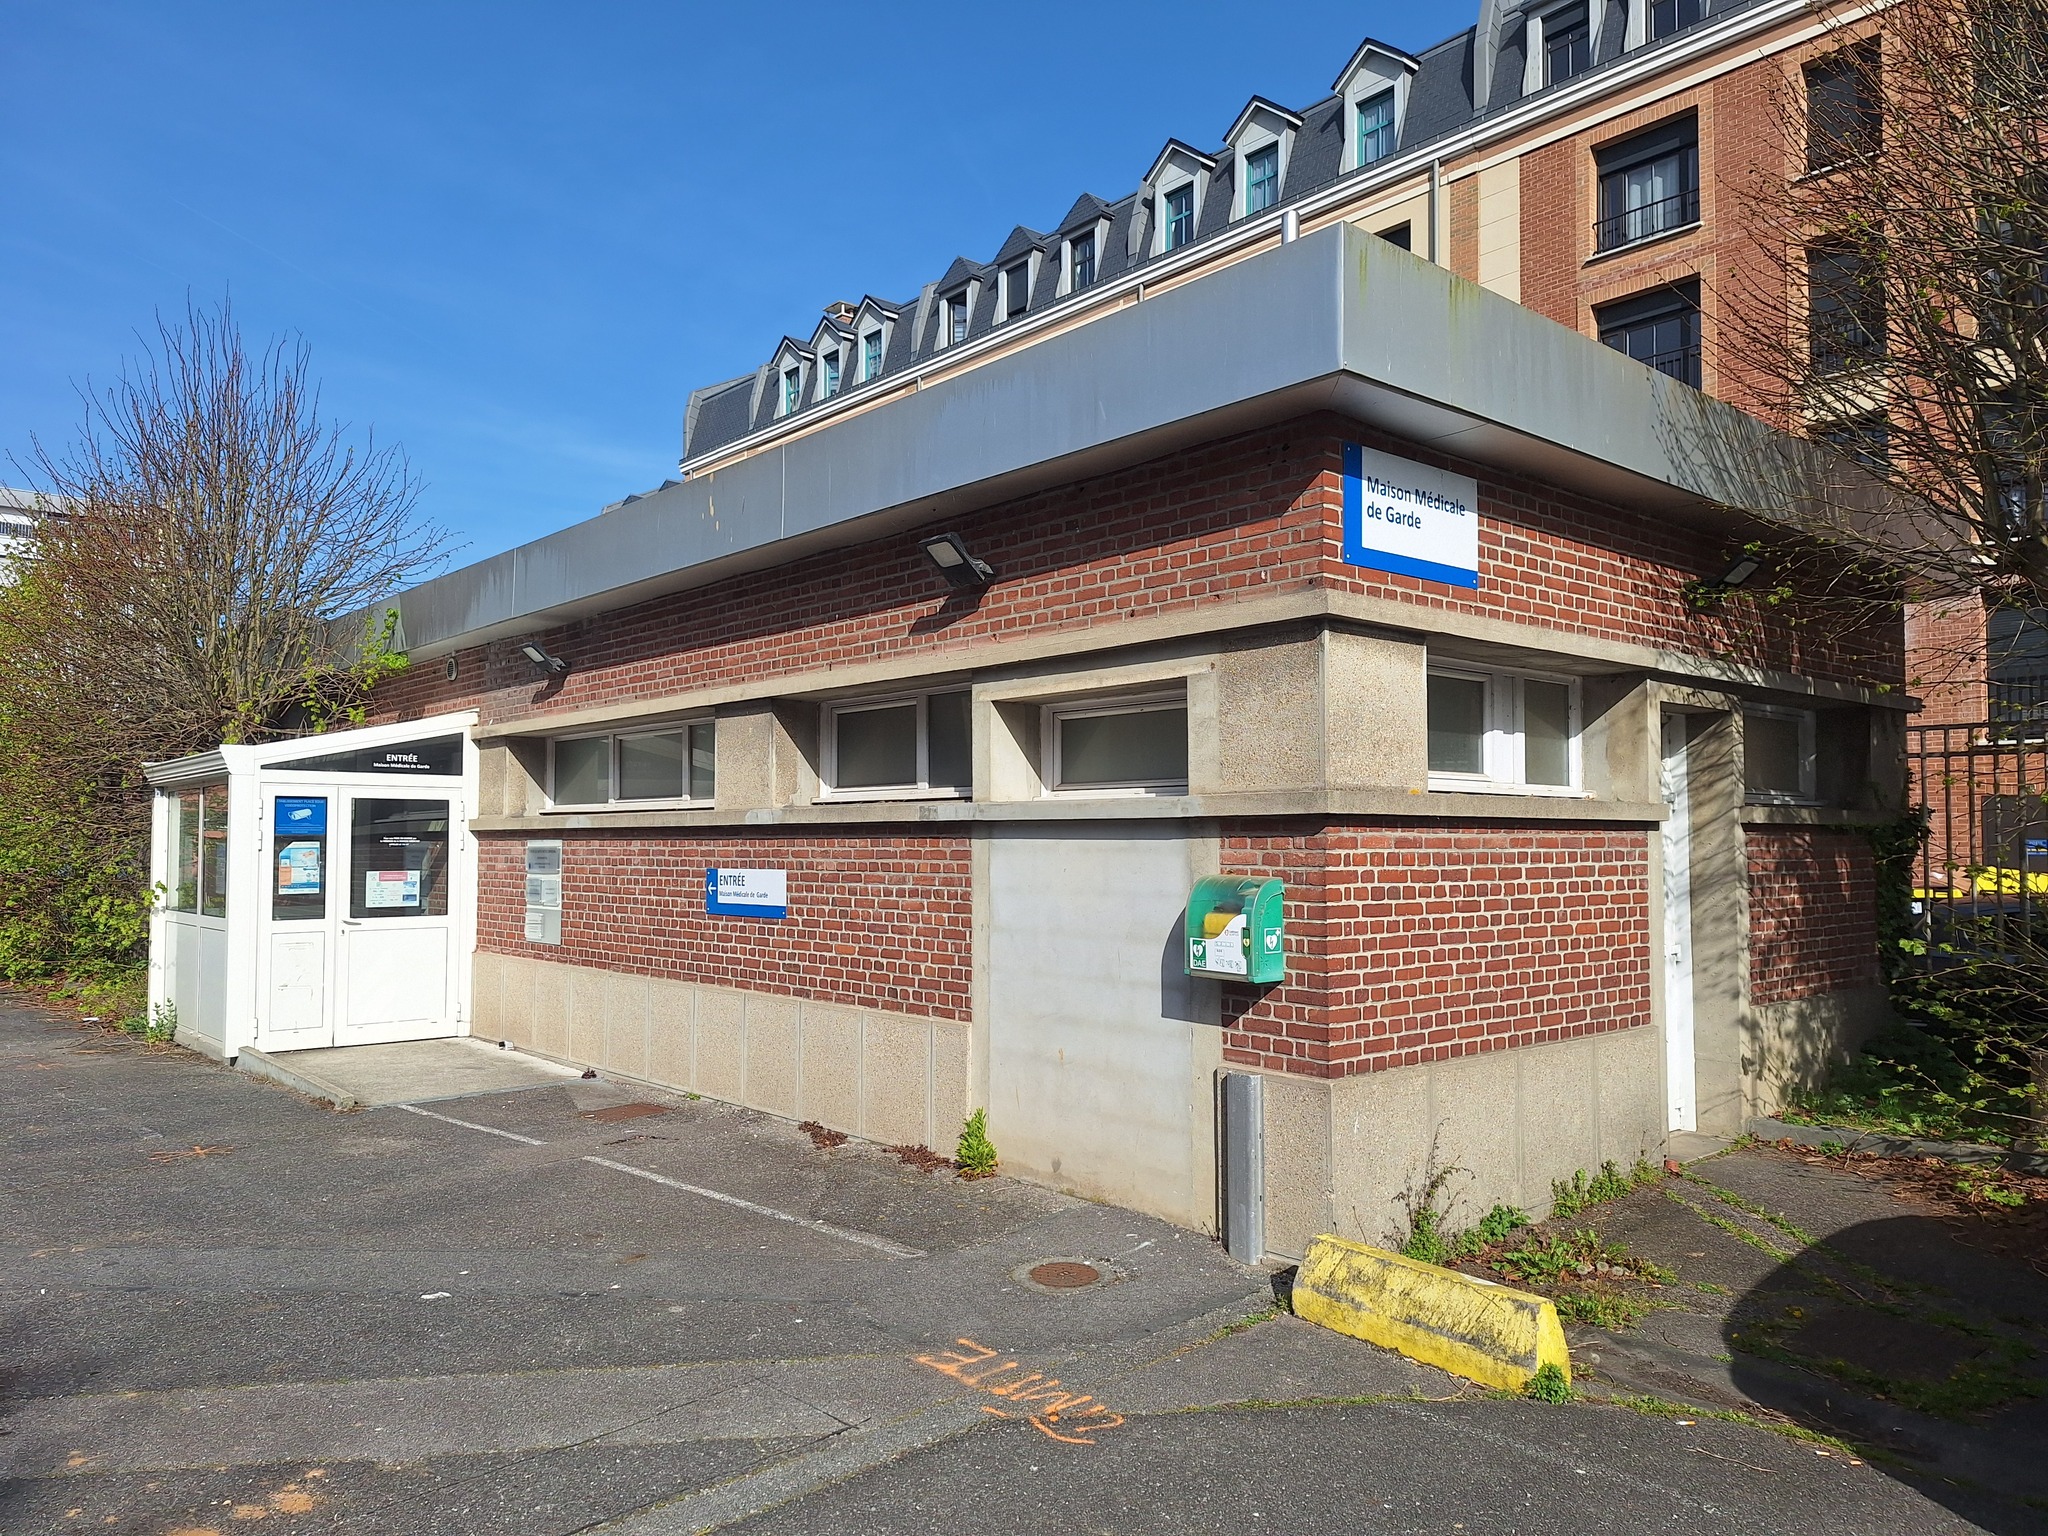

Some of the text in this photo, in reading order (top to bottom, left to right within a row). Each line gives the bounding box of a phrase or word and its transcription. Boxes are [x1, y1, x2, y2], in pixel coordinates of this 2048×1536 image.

[1367, 476, 1465, 516] Maison Médicale
[1367, 501, 1421, 529] de Garde
[386, 753, 418, 762] ENTRÉE
[719, 872, 746, 887] ENTRÉE
[1193, 959, 1206, 968] DAE
